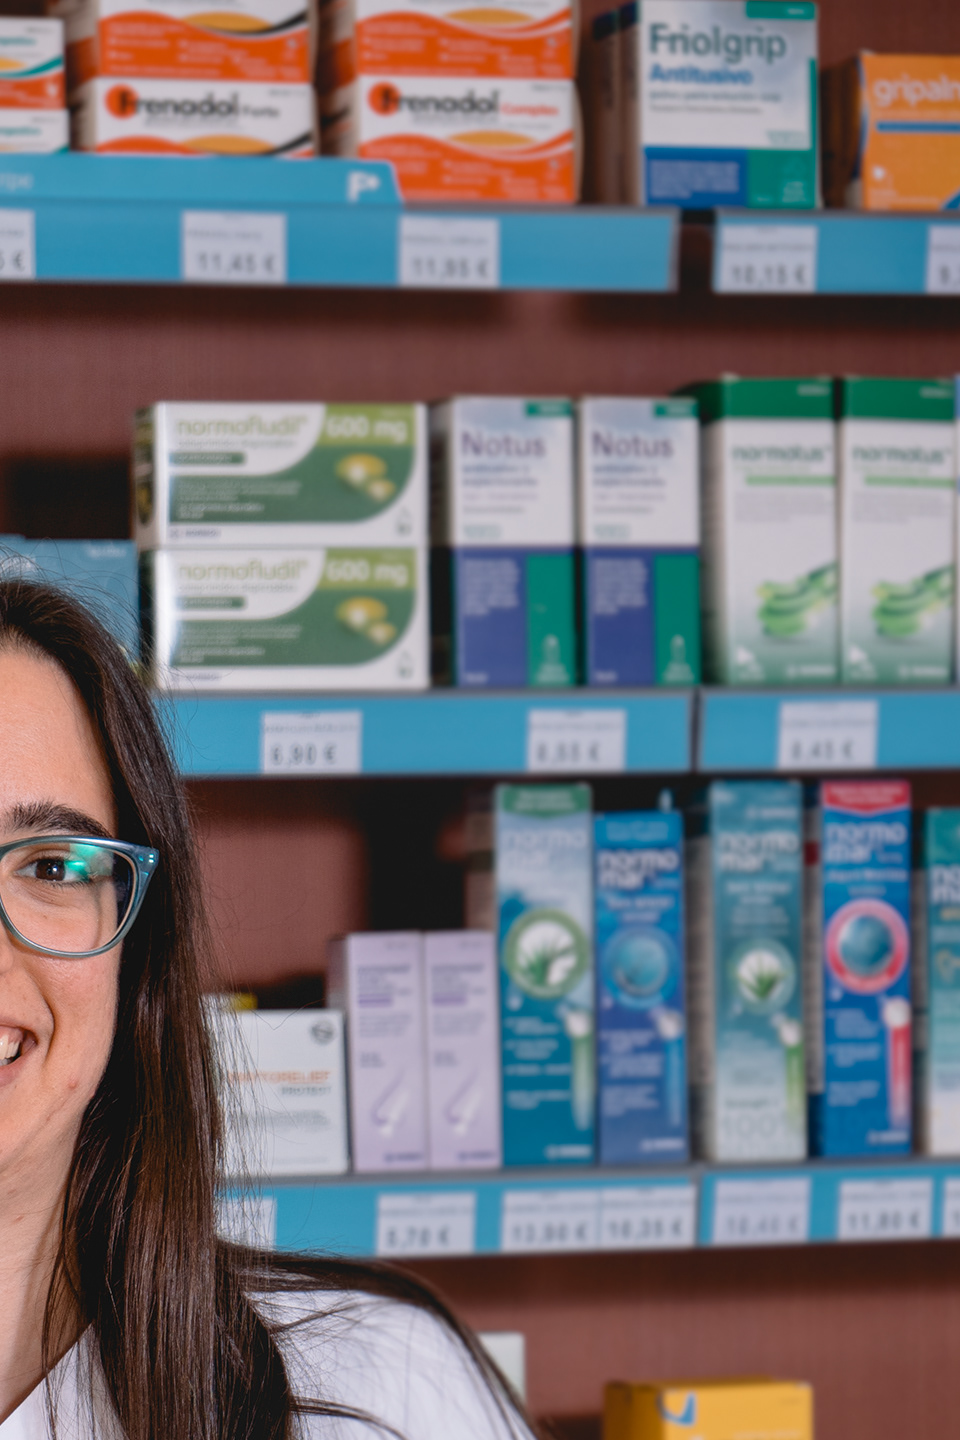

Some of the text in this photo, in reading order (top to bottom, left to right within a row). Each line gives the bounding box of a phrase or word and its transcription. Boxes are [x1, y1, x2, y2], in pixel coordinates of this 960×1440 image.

[649, 23, 788, 64] Friolgrip
[649, 63, 755, 85] Antitusivo
[116, 89, 240, 117] Frenadol
[381, 88, 500, 115] Frenadol
[12, 249, 26, 272] €
[262, 254, 278, 275] €
[475, 257, 489, 279] €
[793, 263, 807, 286] €
[177, 414, 408, 443] normofludil 600 mg
[461, 430, 546, 458] Notus
[591, 430, 674, 458] Notus
[178, 558, 409, 589] normofludil 600 mg
[323, 744, 337, 765] €
[586, 741, 601, 764] €
[842, 738, 856, 762] €
[717, 832, 800, 854] normo
[826, 822, 908, 845] normo
[598, 849, 680, 872] normo
[719, 853, 764, 872] mar
[828, 844, 872, 864] mar
[600, 872, 645, 890] mar
